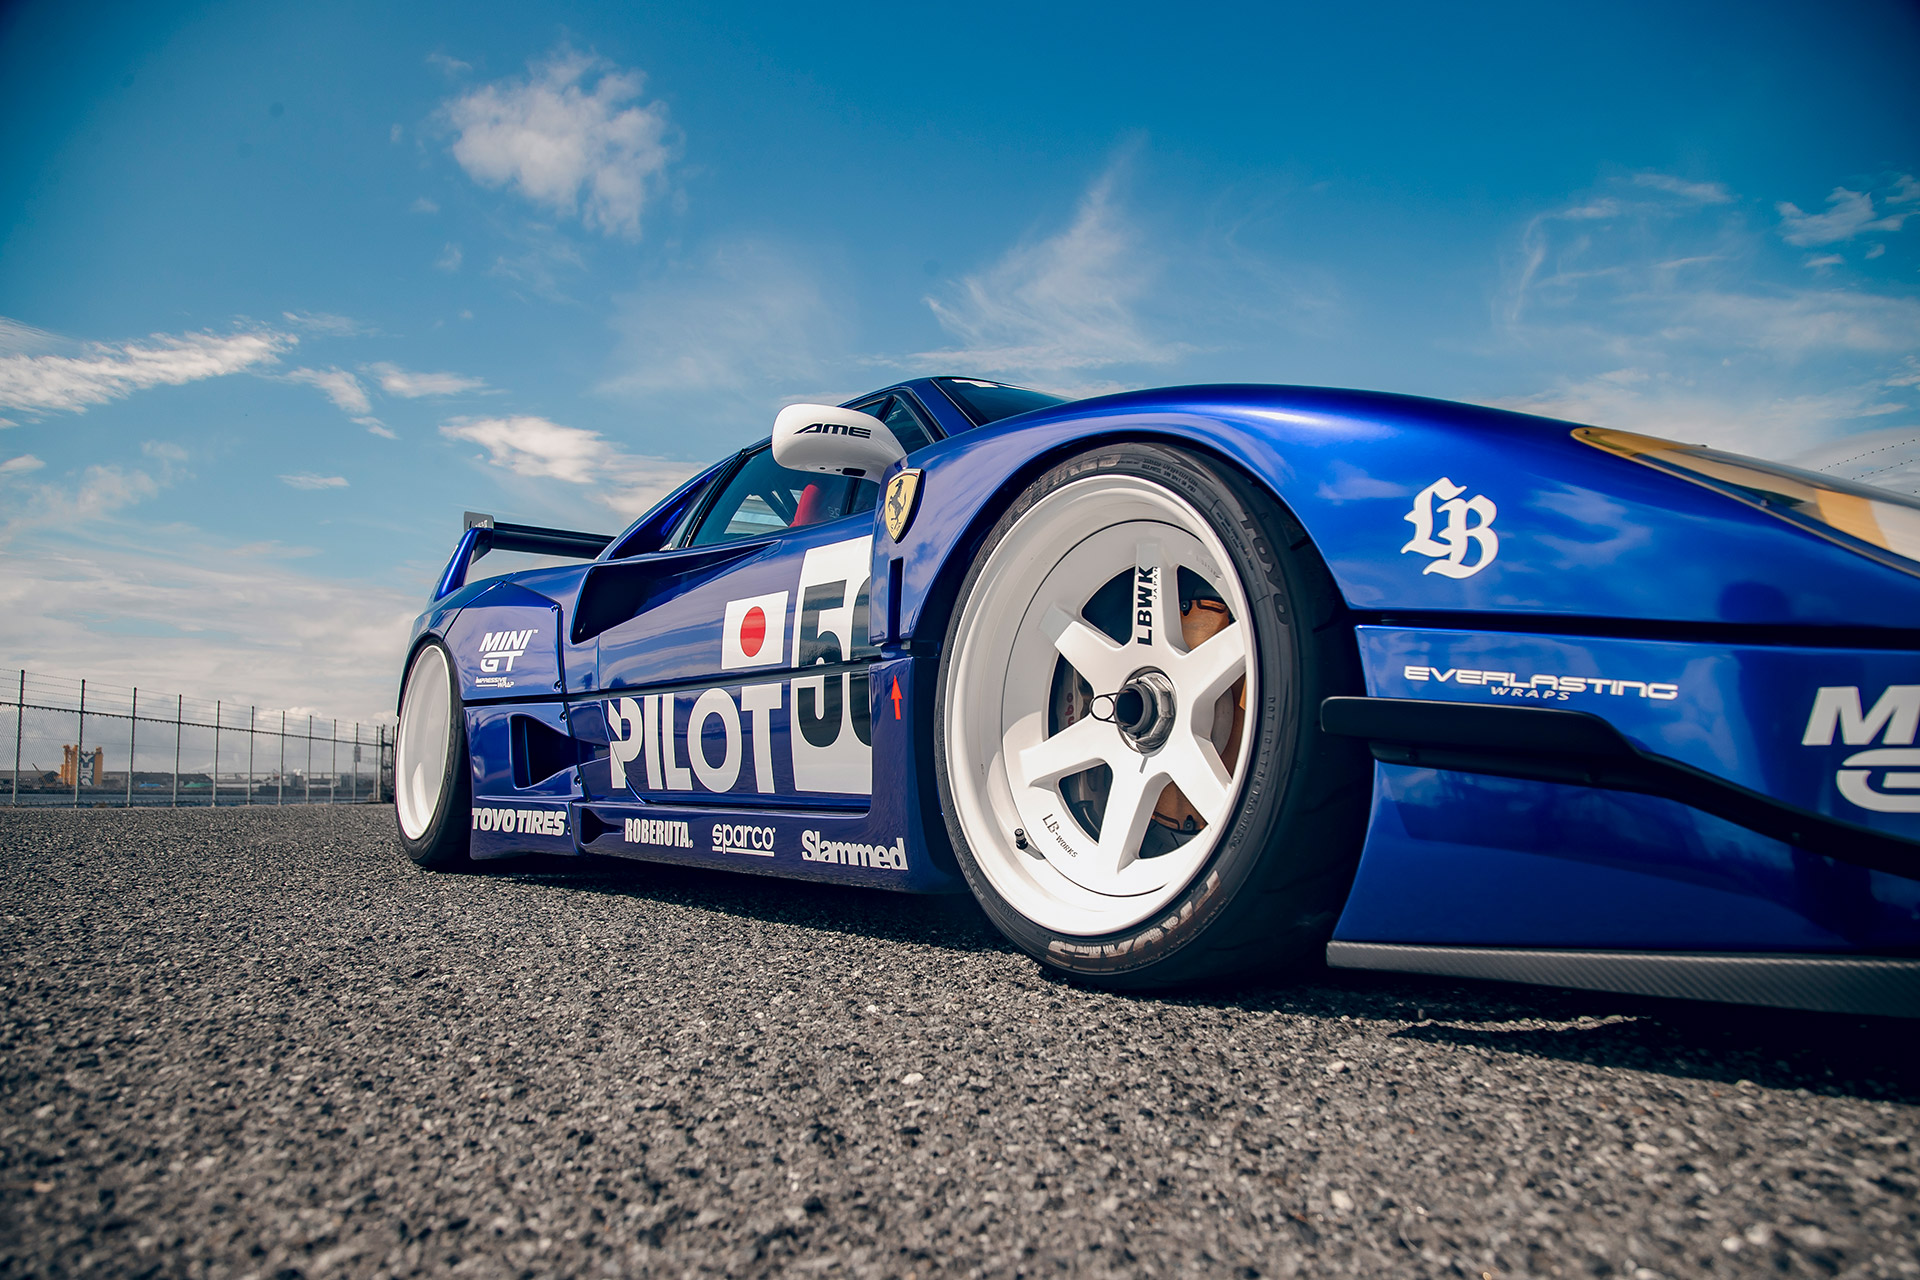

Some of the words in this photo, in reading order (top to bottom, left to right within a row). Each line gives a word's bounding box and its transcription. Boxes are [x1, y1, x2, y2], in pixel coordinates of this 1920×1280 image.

[793, 423, 872, 439] AME
[1240, 512, 1290, 626] TOYO
[1137, 566, 1153, 646] LBWK
[478, 629, 534, 652] MINI
[480, 650, 525, 673] GT
[1403, 665, 1679, 700] EVERLASTING
[1490, 685, 1571, 701] WRAPS
[607, 686, 783, 794] PILOT
[472, 808, 516, 832] TOYO
[517, 810, 567, 837] TIRES
[712, 823, 775, 855] sparco
[802, 831, 908, 871] Slammed
